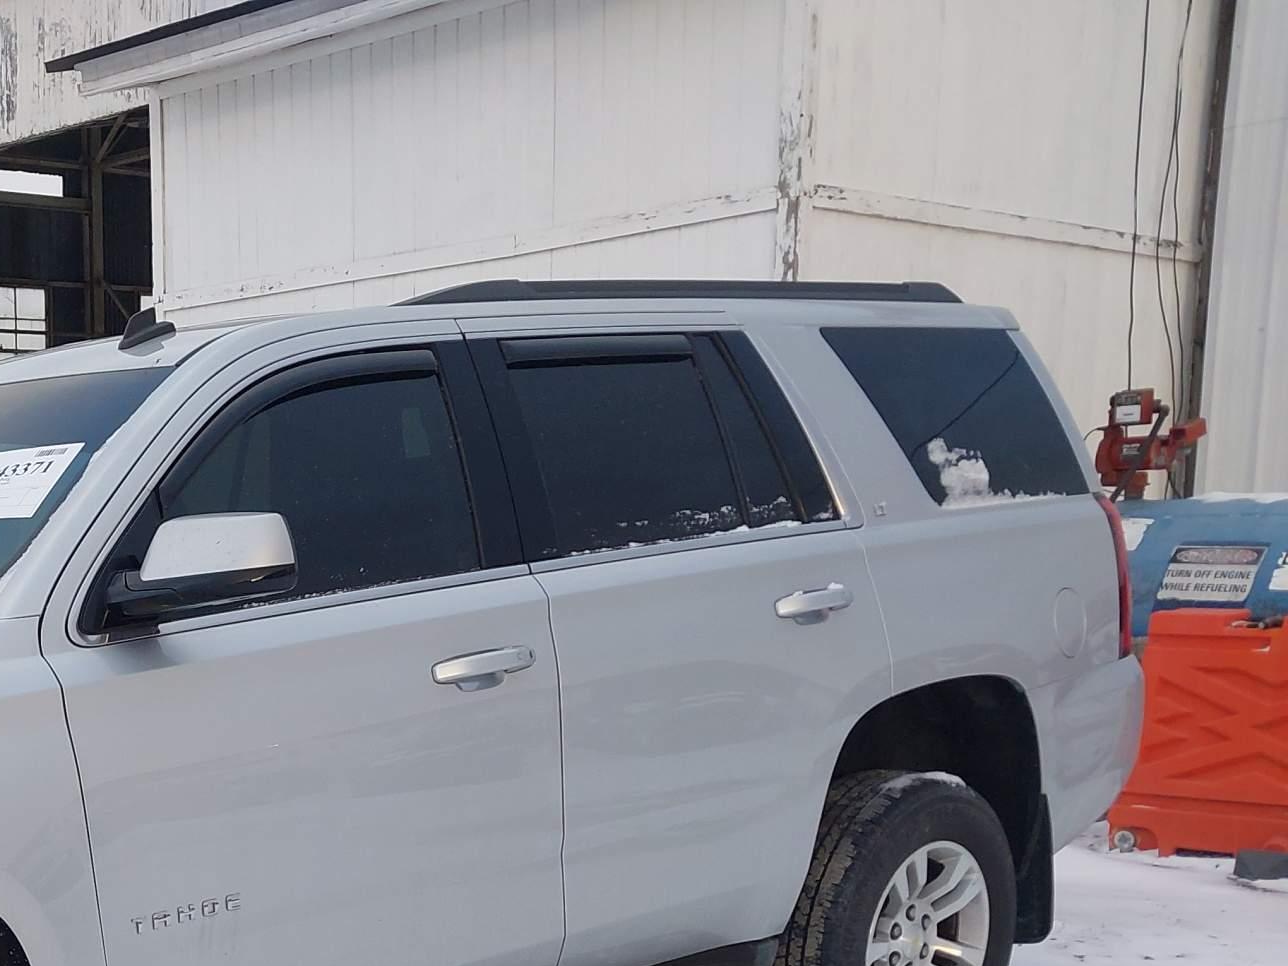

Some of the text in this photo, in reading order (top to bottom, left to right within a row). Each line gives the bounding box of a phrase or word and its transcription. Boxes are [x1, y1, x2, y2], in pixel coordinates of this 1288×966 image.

[1165, 569, 1253, 580] TURN OFF ENGINE
[1160, 582, 1248, 593] WHILE REFUELING
[130, 892, 241, 936] TAHOE
